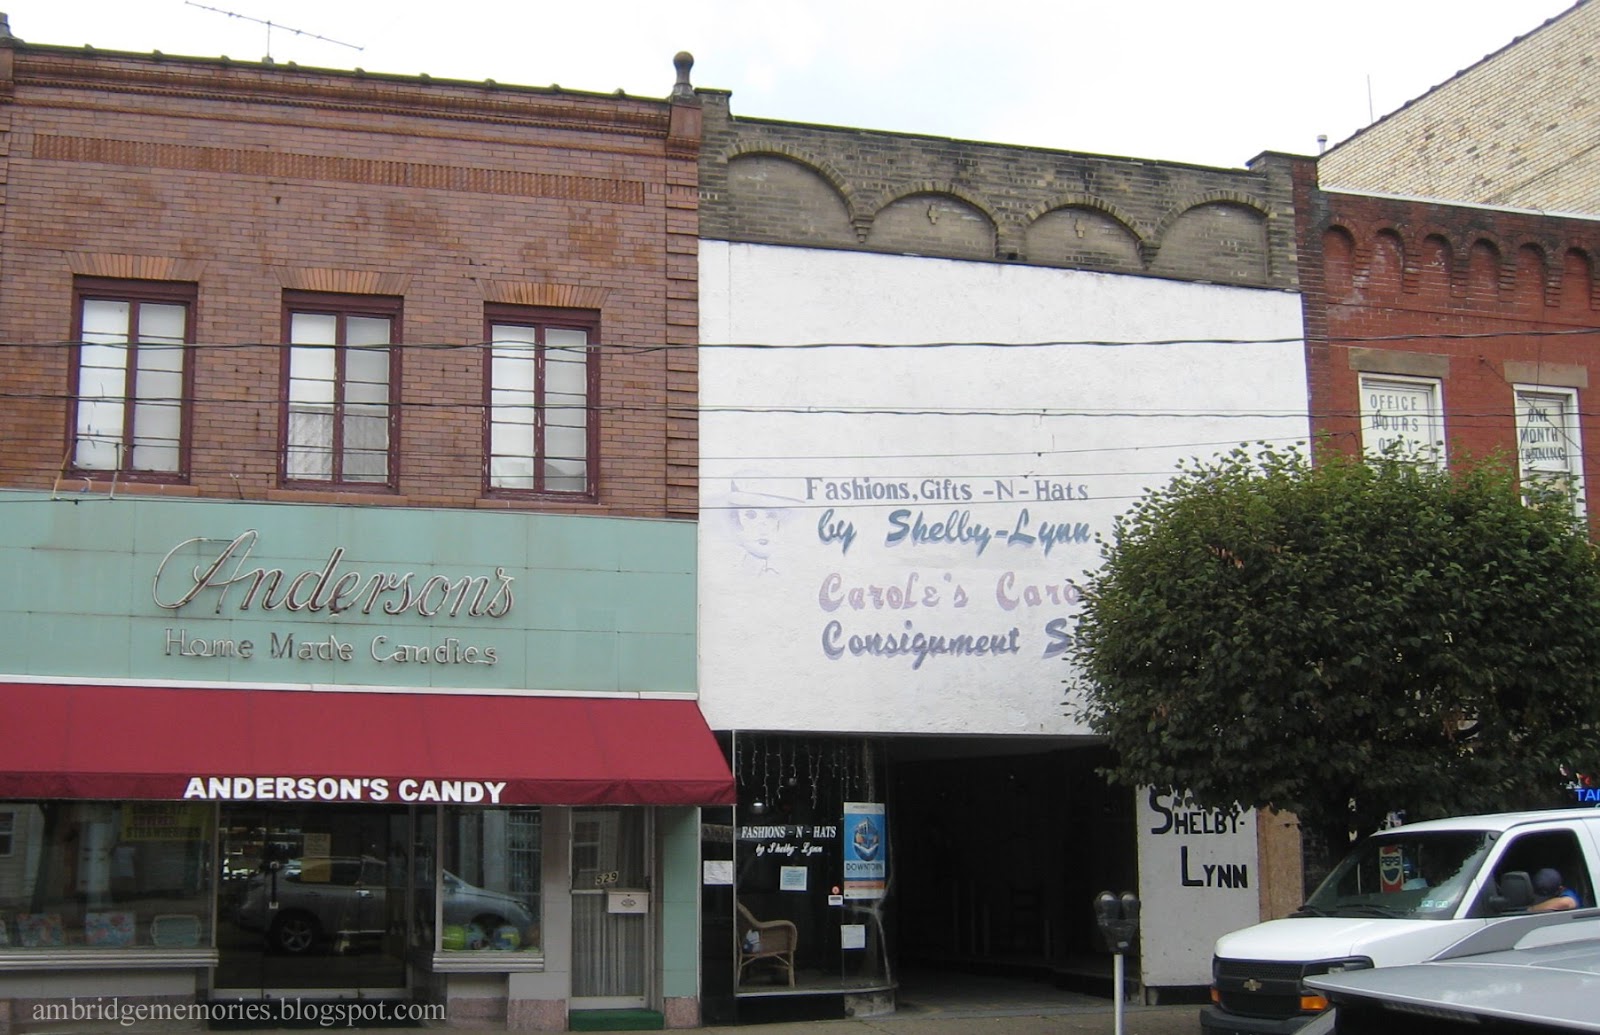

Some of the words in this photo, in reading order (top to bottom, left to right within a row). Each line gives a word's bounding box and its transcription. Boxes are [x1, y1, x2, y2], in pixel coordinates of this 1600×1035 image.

[1370, 394, 1417, 411] OFFICE
[1372, 415, 1419, 432] HOURS
[1528, 408, 1549, 422] ONE
[1520, 428, 1558, 443] MONTH
[1378, 437, 1413, 454] OY
[818, 508, 857, 556] by
[165, 628, 254, 659] Home
[270, 632, 354, 662] Made
[371, 636, 498, 666] Candies
[822, 620, 1020, 670] Consignment
[183, 776, 389, 801] ANDERSON'S
[398, 779, 507, 804] CANDY
[741, 826, 786, 838] FASHIONS
[813, 826, 837, 838] HATS
[756, 843, 765, 856] by
[1181, 845, 1249, 889] LYNN
[596, 872, 618, 884] 529
